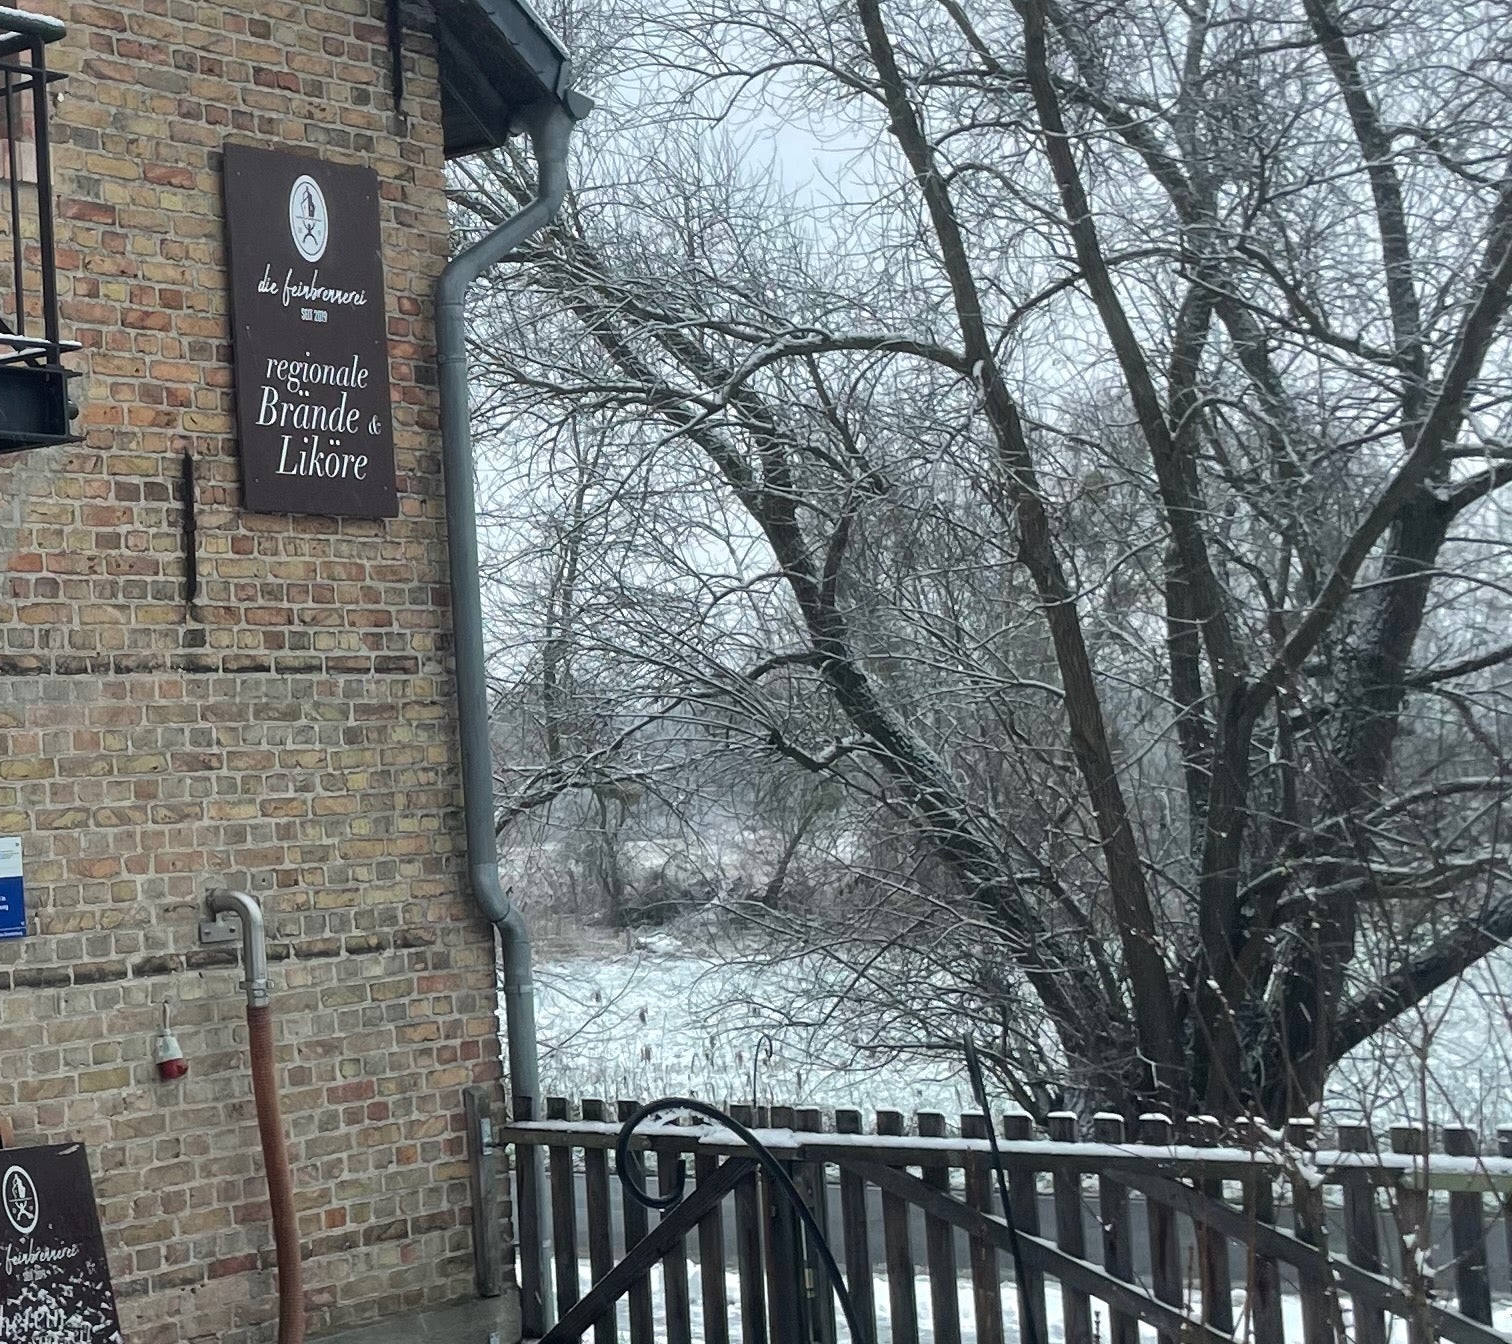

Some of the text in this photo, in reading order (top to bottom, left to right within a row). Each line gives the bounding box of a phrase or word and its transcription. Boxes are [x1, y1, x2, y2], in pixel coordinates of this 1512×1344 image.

[257, 263, 367, 307] die feinbrennerei
[266, 351, 369, 393] regionale
[255, 385, 382, 435] Brände &
[275, 434, 368, 480] Liköre
